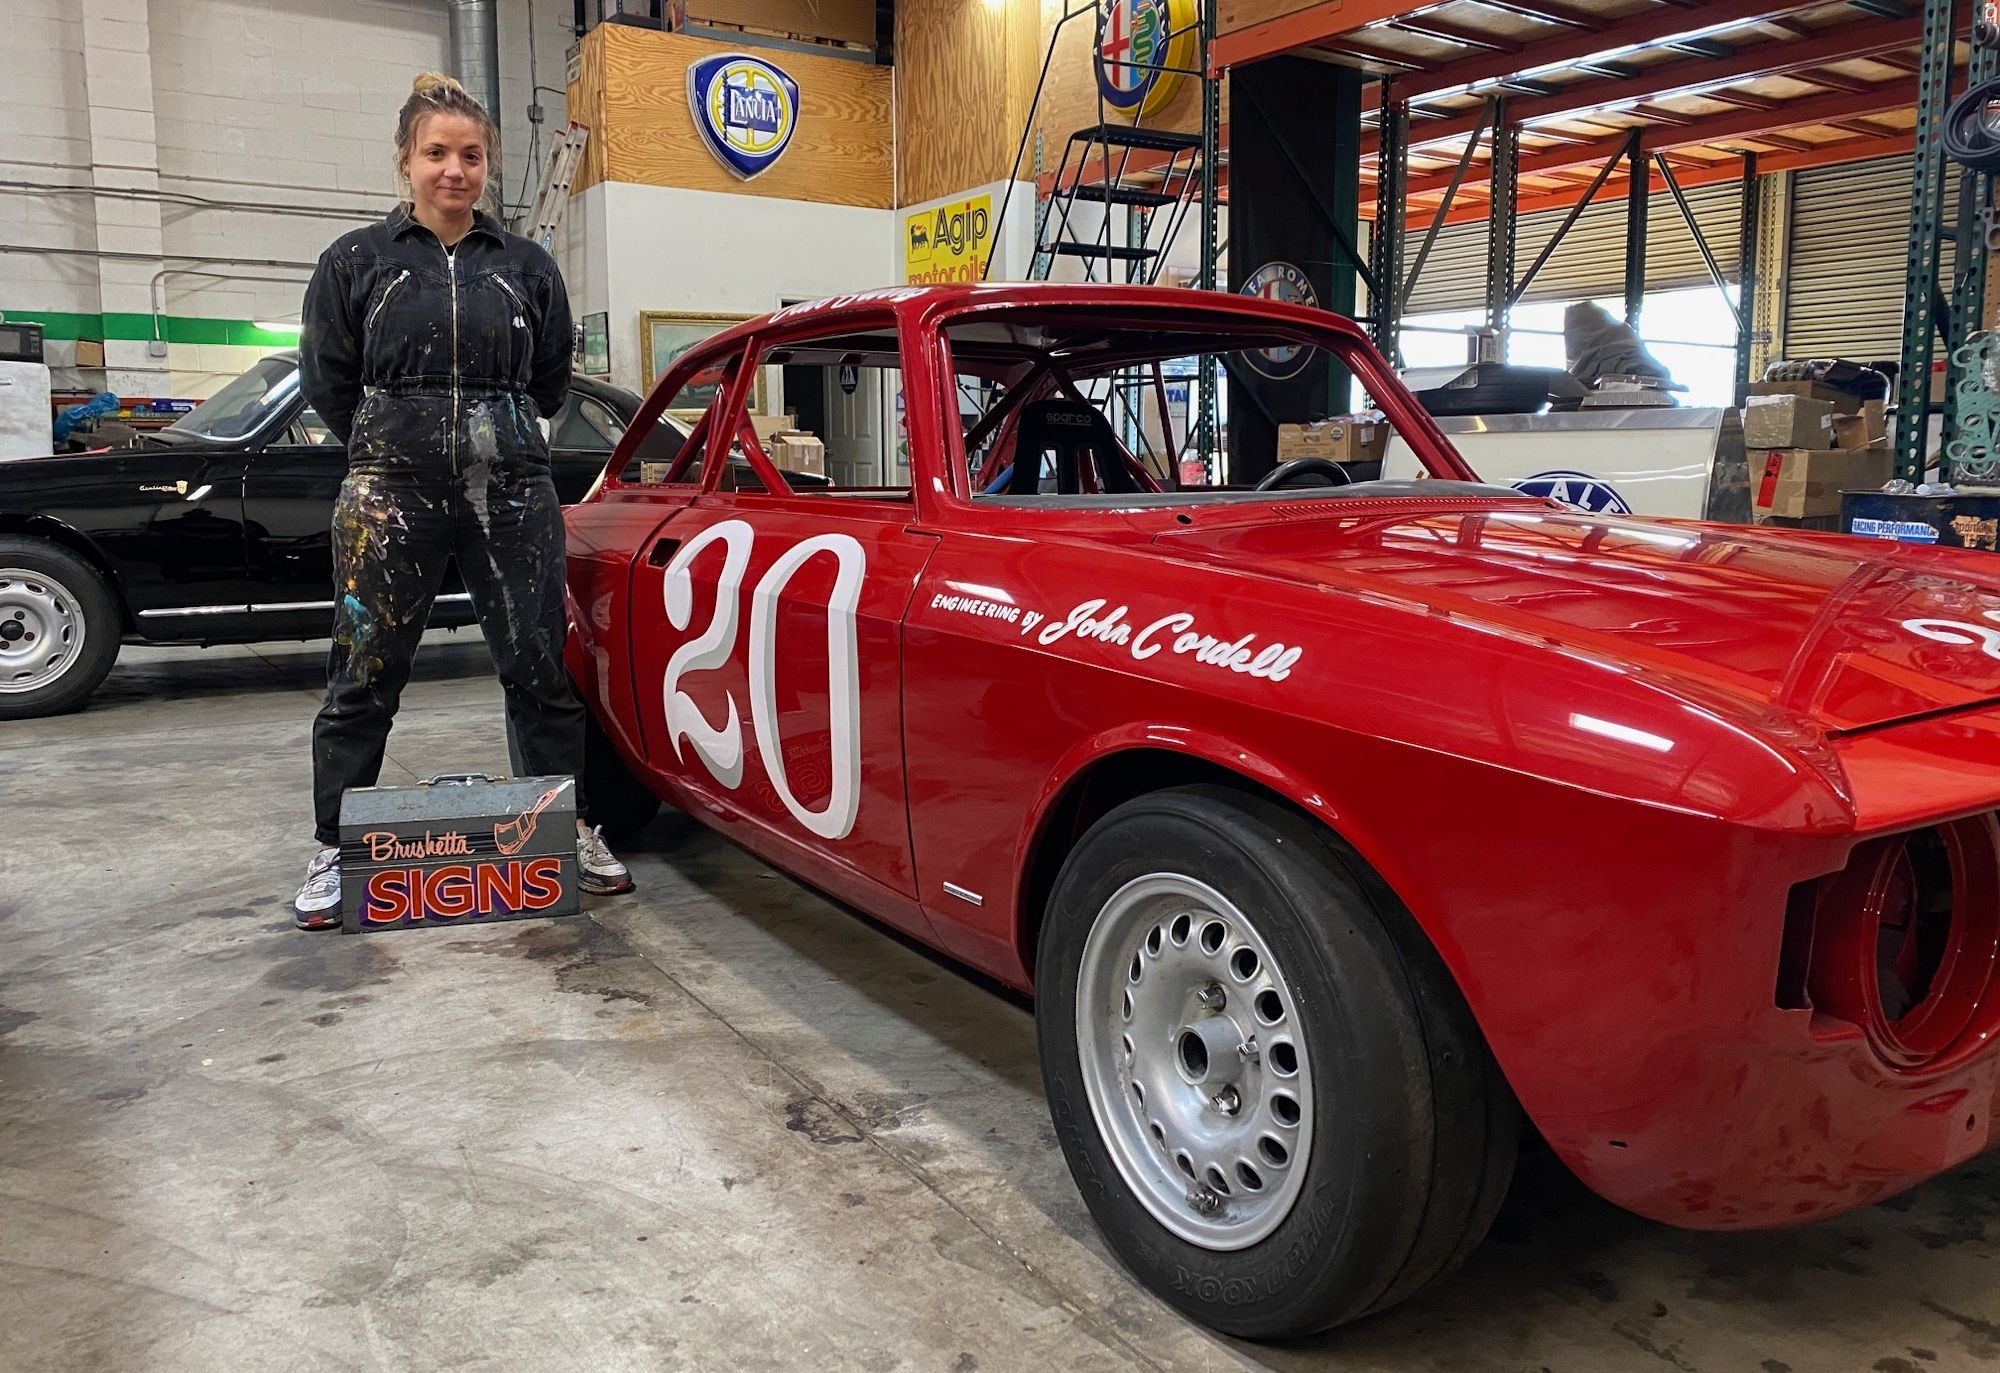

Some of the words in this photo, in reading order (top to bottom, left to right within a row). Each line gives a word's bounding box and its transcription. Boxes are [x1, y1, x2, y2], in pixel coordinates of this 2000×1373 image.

[933, 202, 987, 255] Agip
[909, 263, 955, 284] motor
[1853, 520, 1876, 533] RACING
[931, 593, 1021, 623] ENGINEERING
[1020, 611, 1045, 636] BY
[1038, 598, 1133, 646] John
[1131, 612, 1303, 682] Cordell
[663, 519, 866, 840] 20
[362, 830, 475, 861] Brushetta
[362, 857, 562, 926] SIGNS
